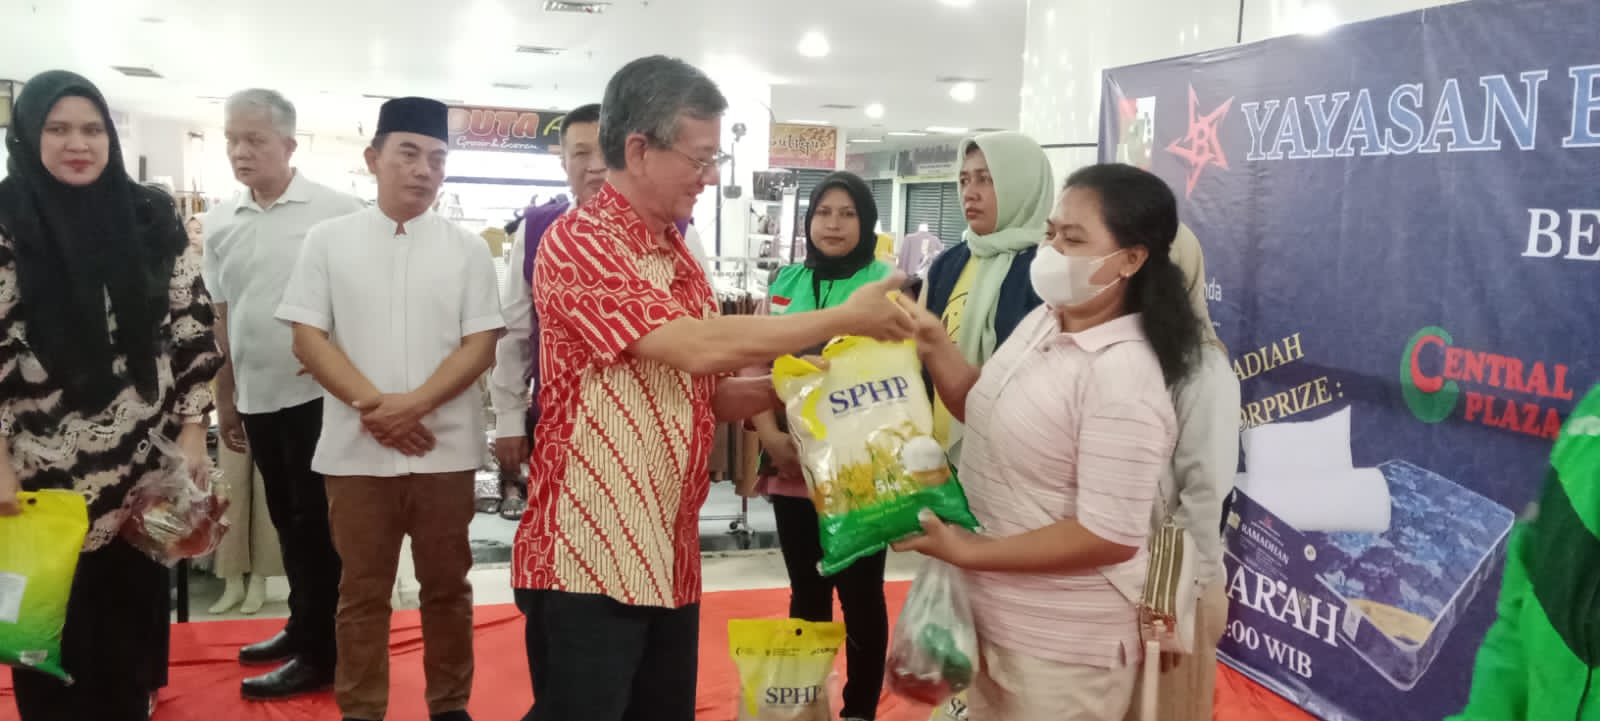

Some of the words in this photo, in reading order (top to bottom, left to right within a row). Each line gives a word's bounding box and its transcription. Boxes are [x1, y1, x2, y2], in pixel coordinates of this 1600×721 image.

[1241, 70, 1548, 161] YAYASAN
[1231, 332, 1304, 381] ADIAH
[1410, 335, 1574, 400] CENTRAL
[829, 376, 908, 415] SPHP
[1464, 391, 1562, 440] PLAZA
[1241, 522, 1289, 566] RAMADHAN
[1226, 565, 1341, 648] ARAH
[1227, 619, 1260, 651] :00
[1262, 632, 1313, 679] WIB
